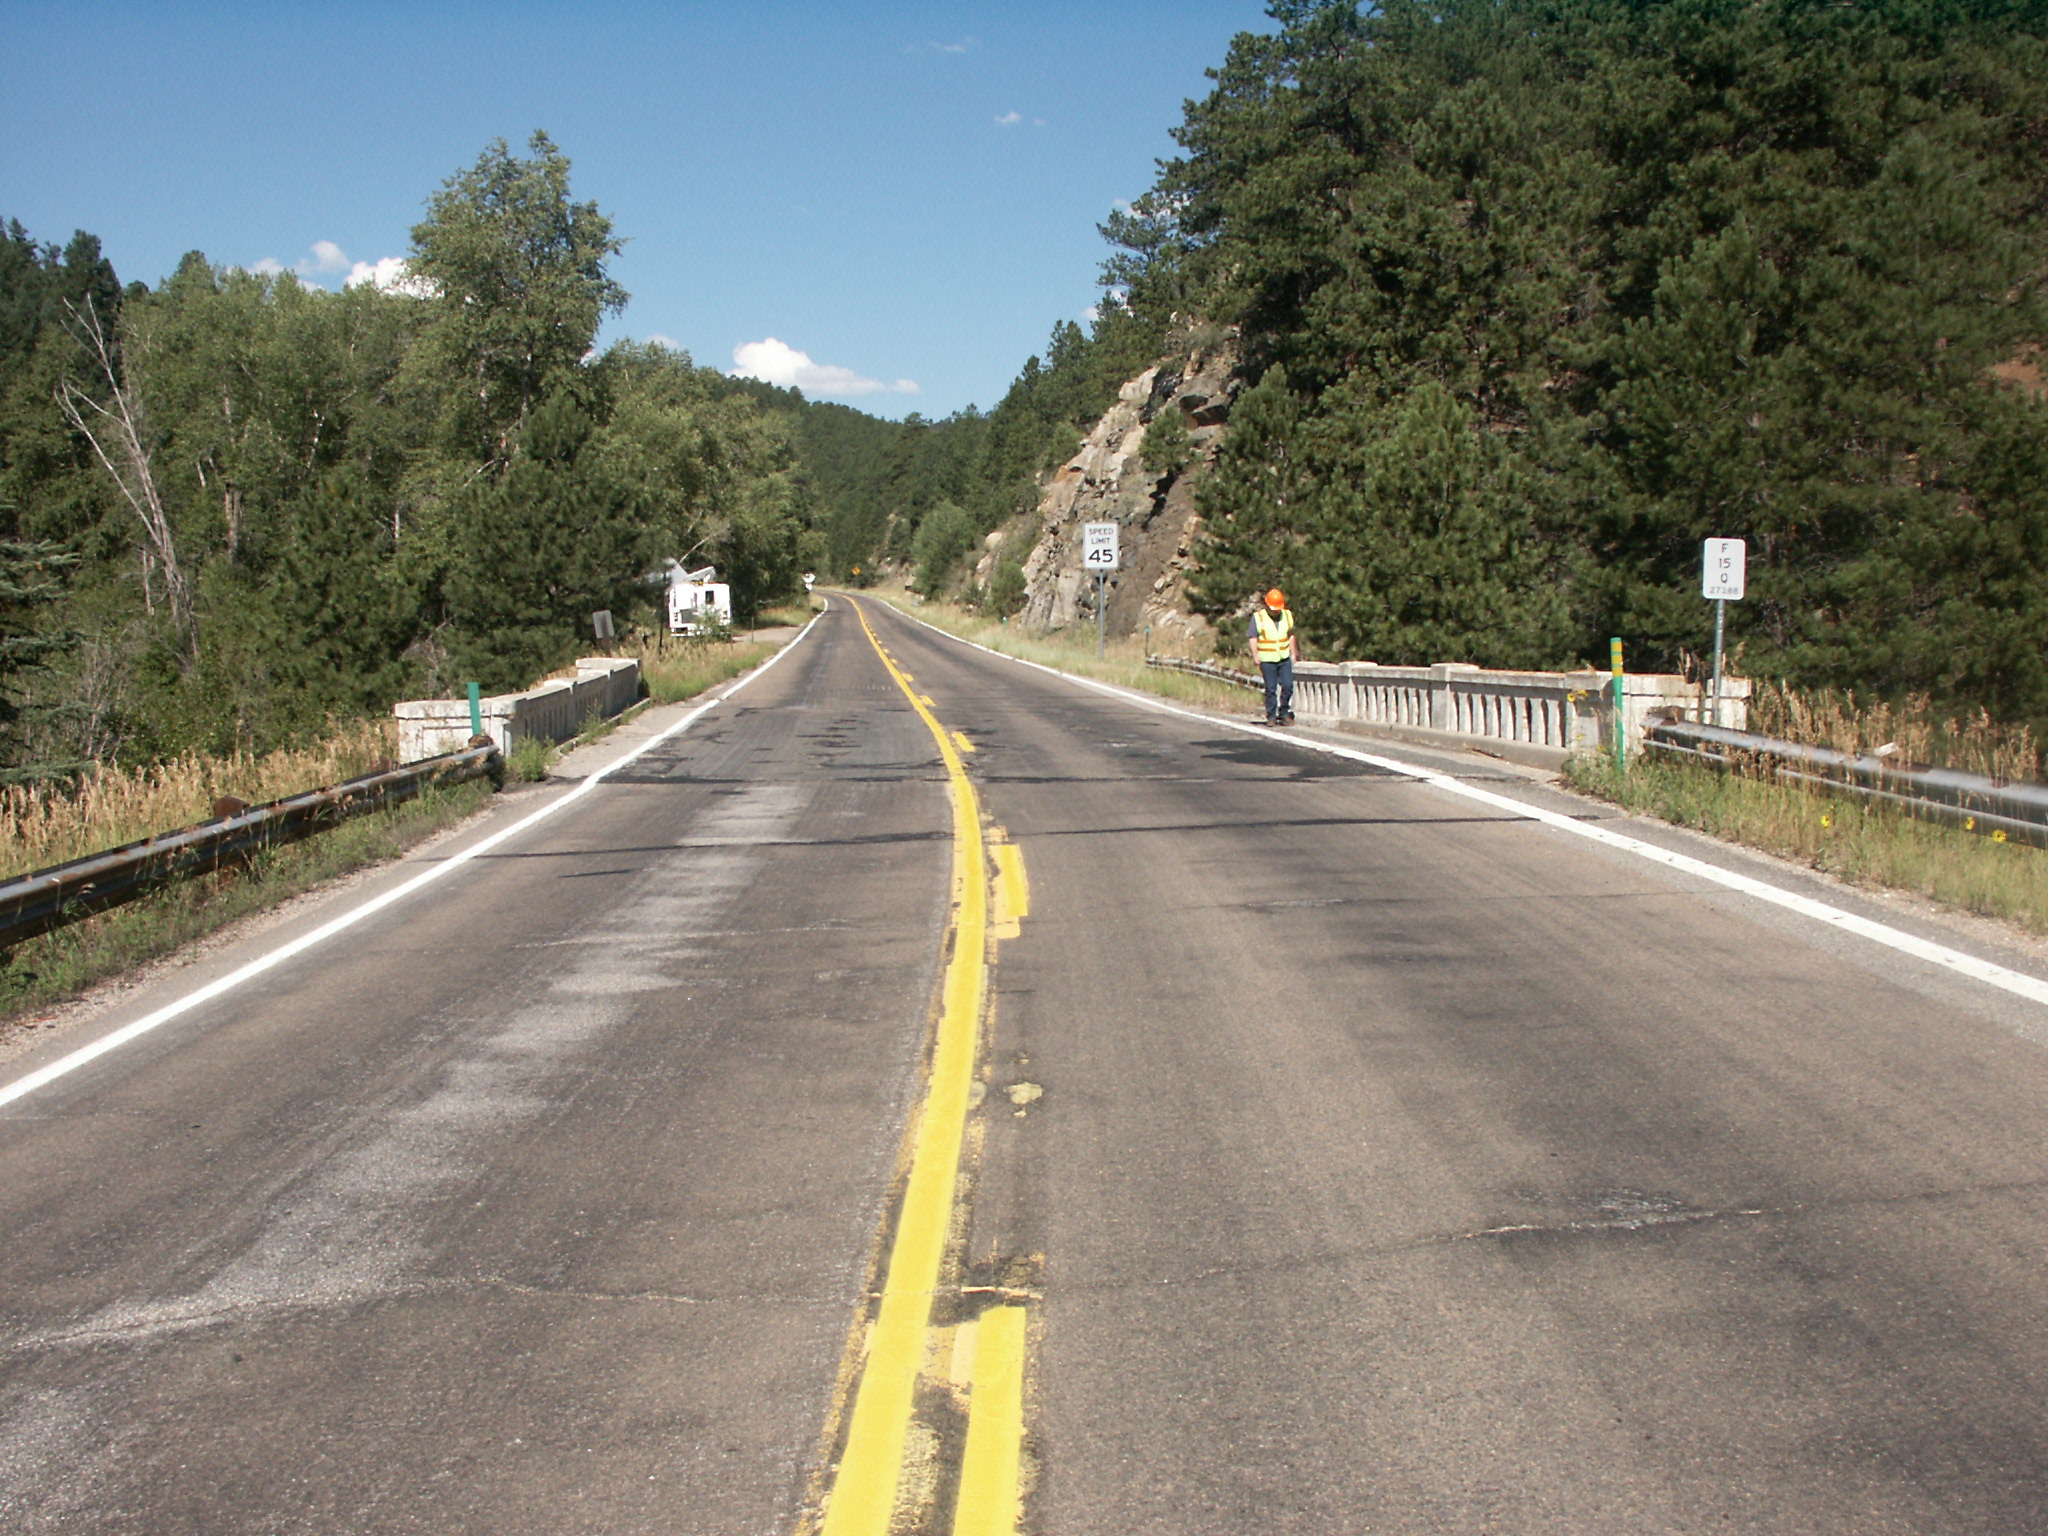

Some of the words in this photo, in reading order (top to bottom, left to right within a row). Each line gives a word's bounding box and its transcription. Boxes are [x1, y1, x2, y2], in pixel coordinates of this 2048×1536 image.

[1091, 537, 1110, 545] LIMIT
[1721, 543, 1728, 553] F
[1088, 549, 1113, 563] 45
[1719, 558, 1731, 569] 15
[1720, 573, 1728, 584] Q
